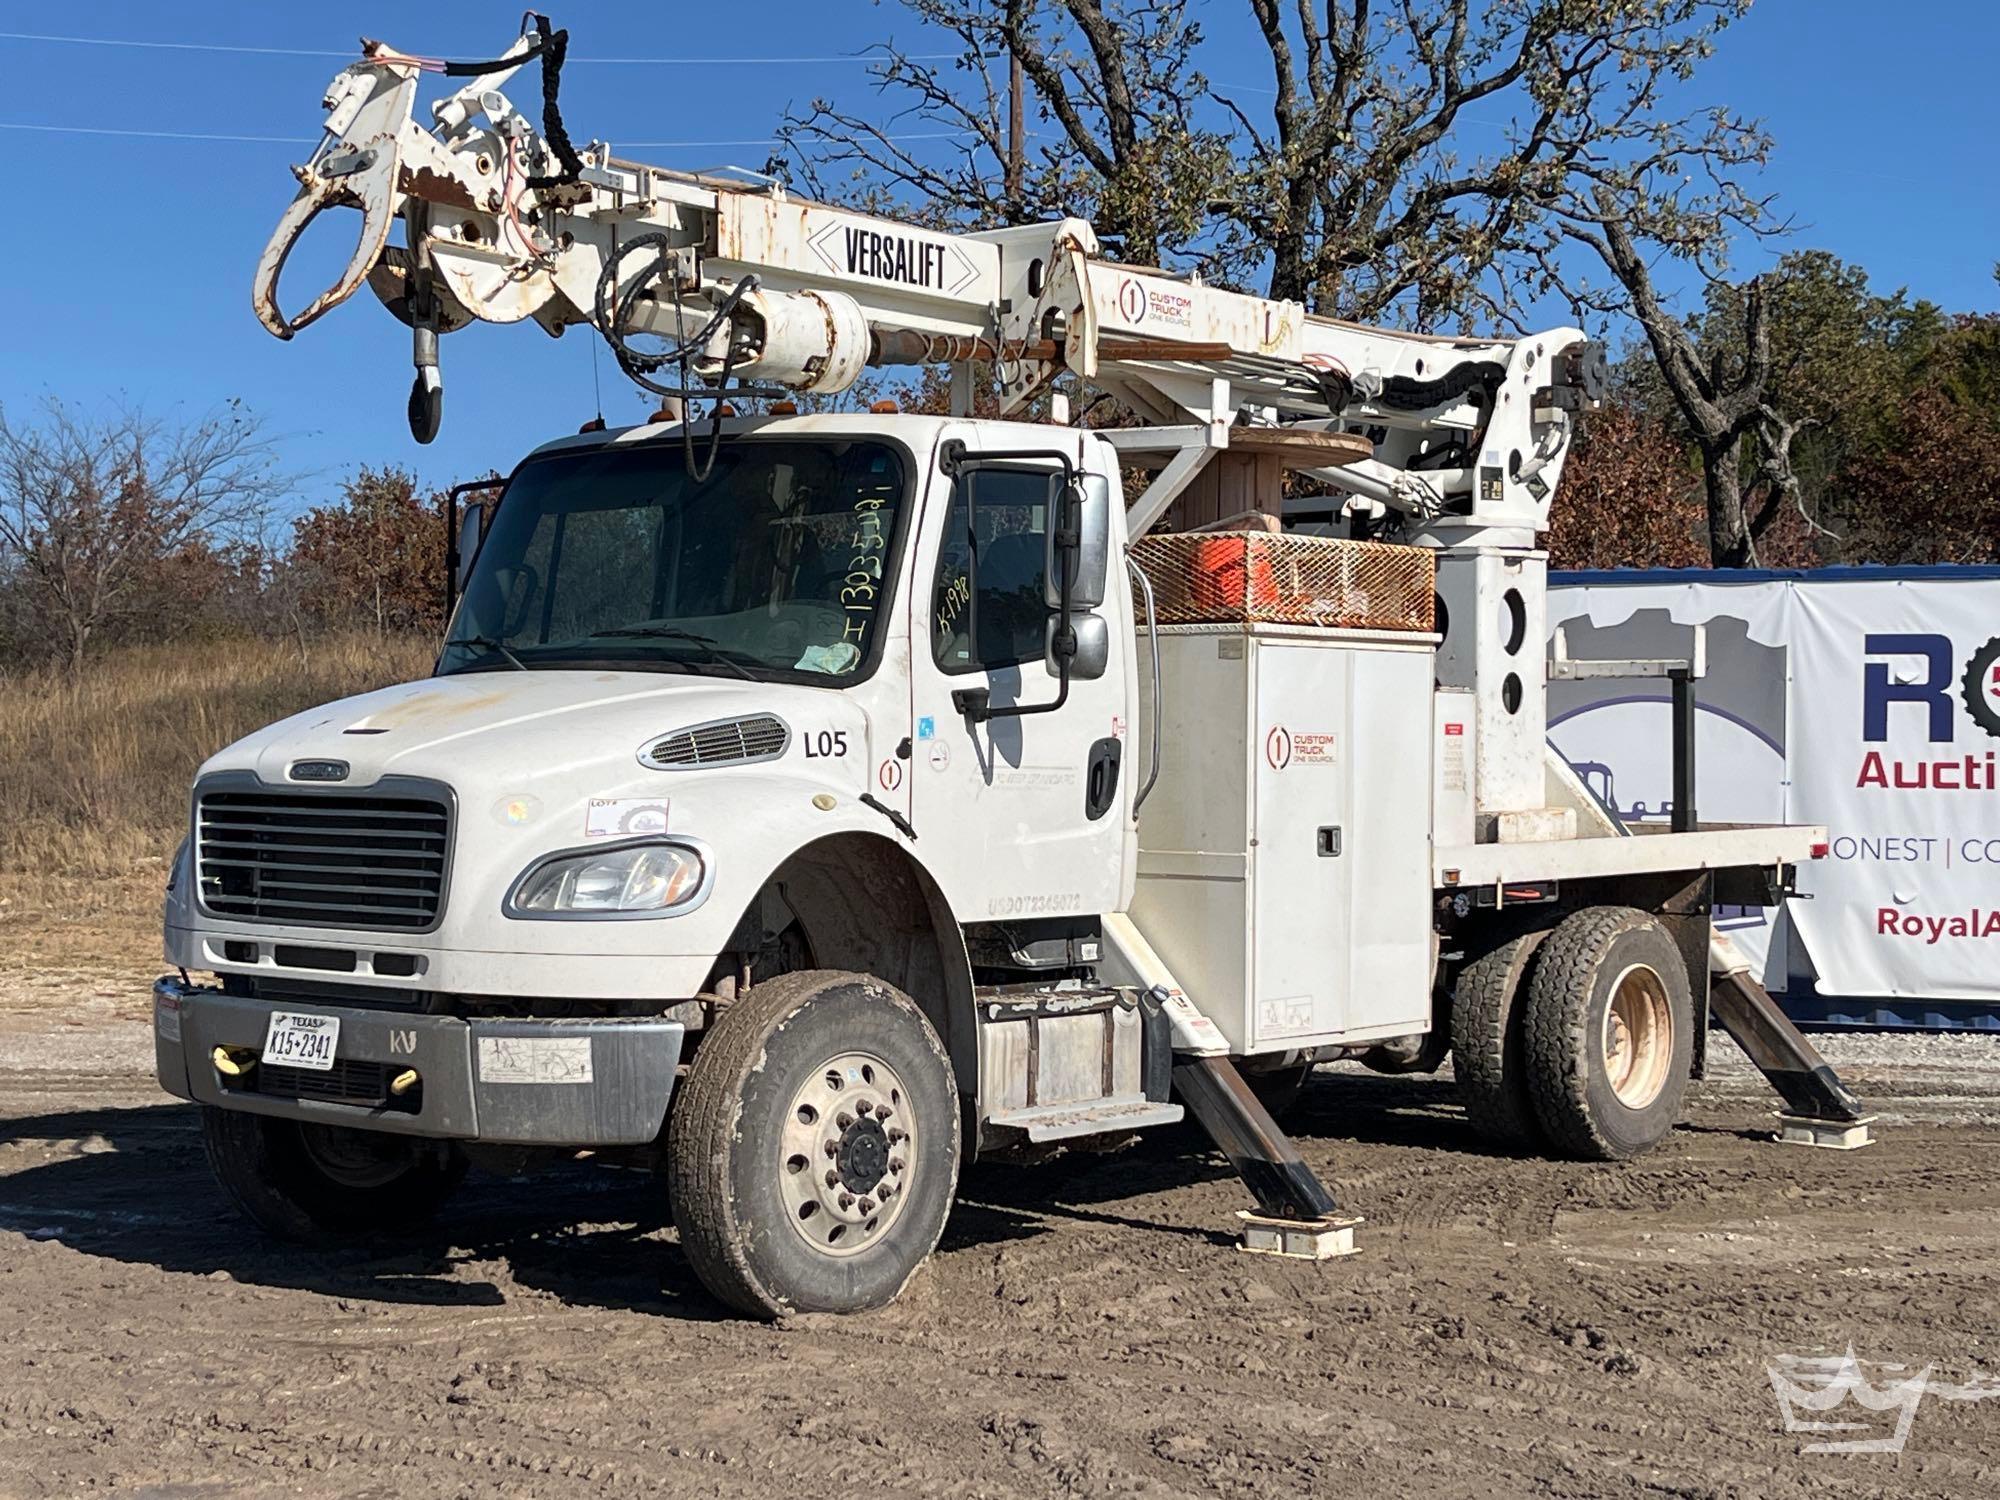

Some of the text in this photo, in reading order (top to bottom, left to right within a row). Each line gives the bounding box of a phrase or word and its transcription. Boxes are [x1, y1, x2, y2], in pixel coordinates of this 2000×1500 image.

[845, 226, 945, 289] VERSALIFT
[1150, 292, 1192, 307] CUSTOM
[1151, 303, 1183, 317] TRUCK
[1149, 314, 1191, 328] ONE SOURCE
[1294, 735, 1334, 745] CUSTOM
[1294, 745, 1325, 755] TRUCK
[1856, 752, 1996, 789] Aucti
[1827, 837, 1938, 861] ONEST
[1877, 908, 2000, 944] RoyalA
[292, 1016, 318, 1028] TEXAS
